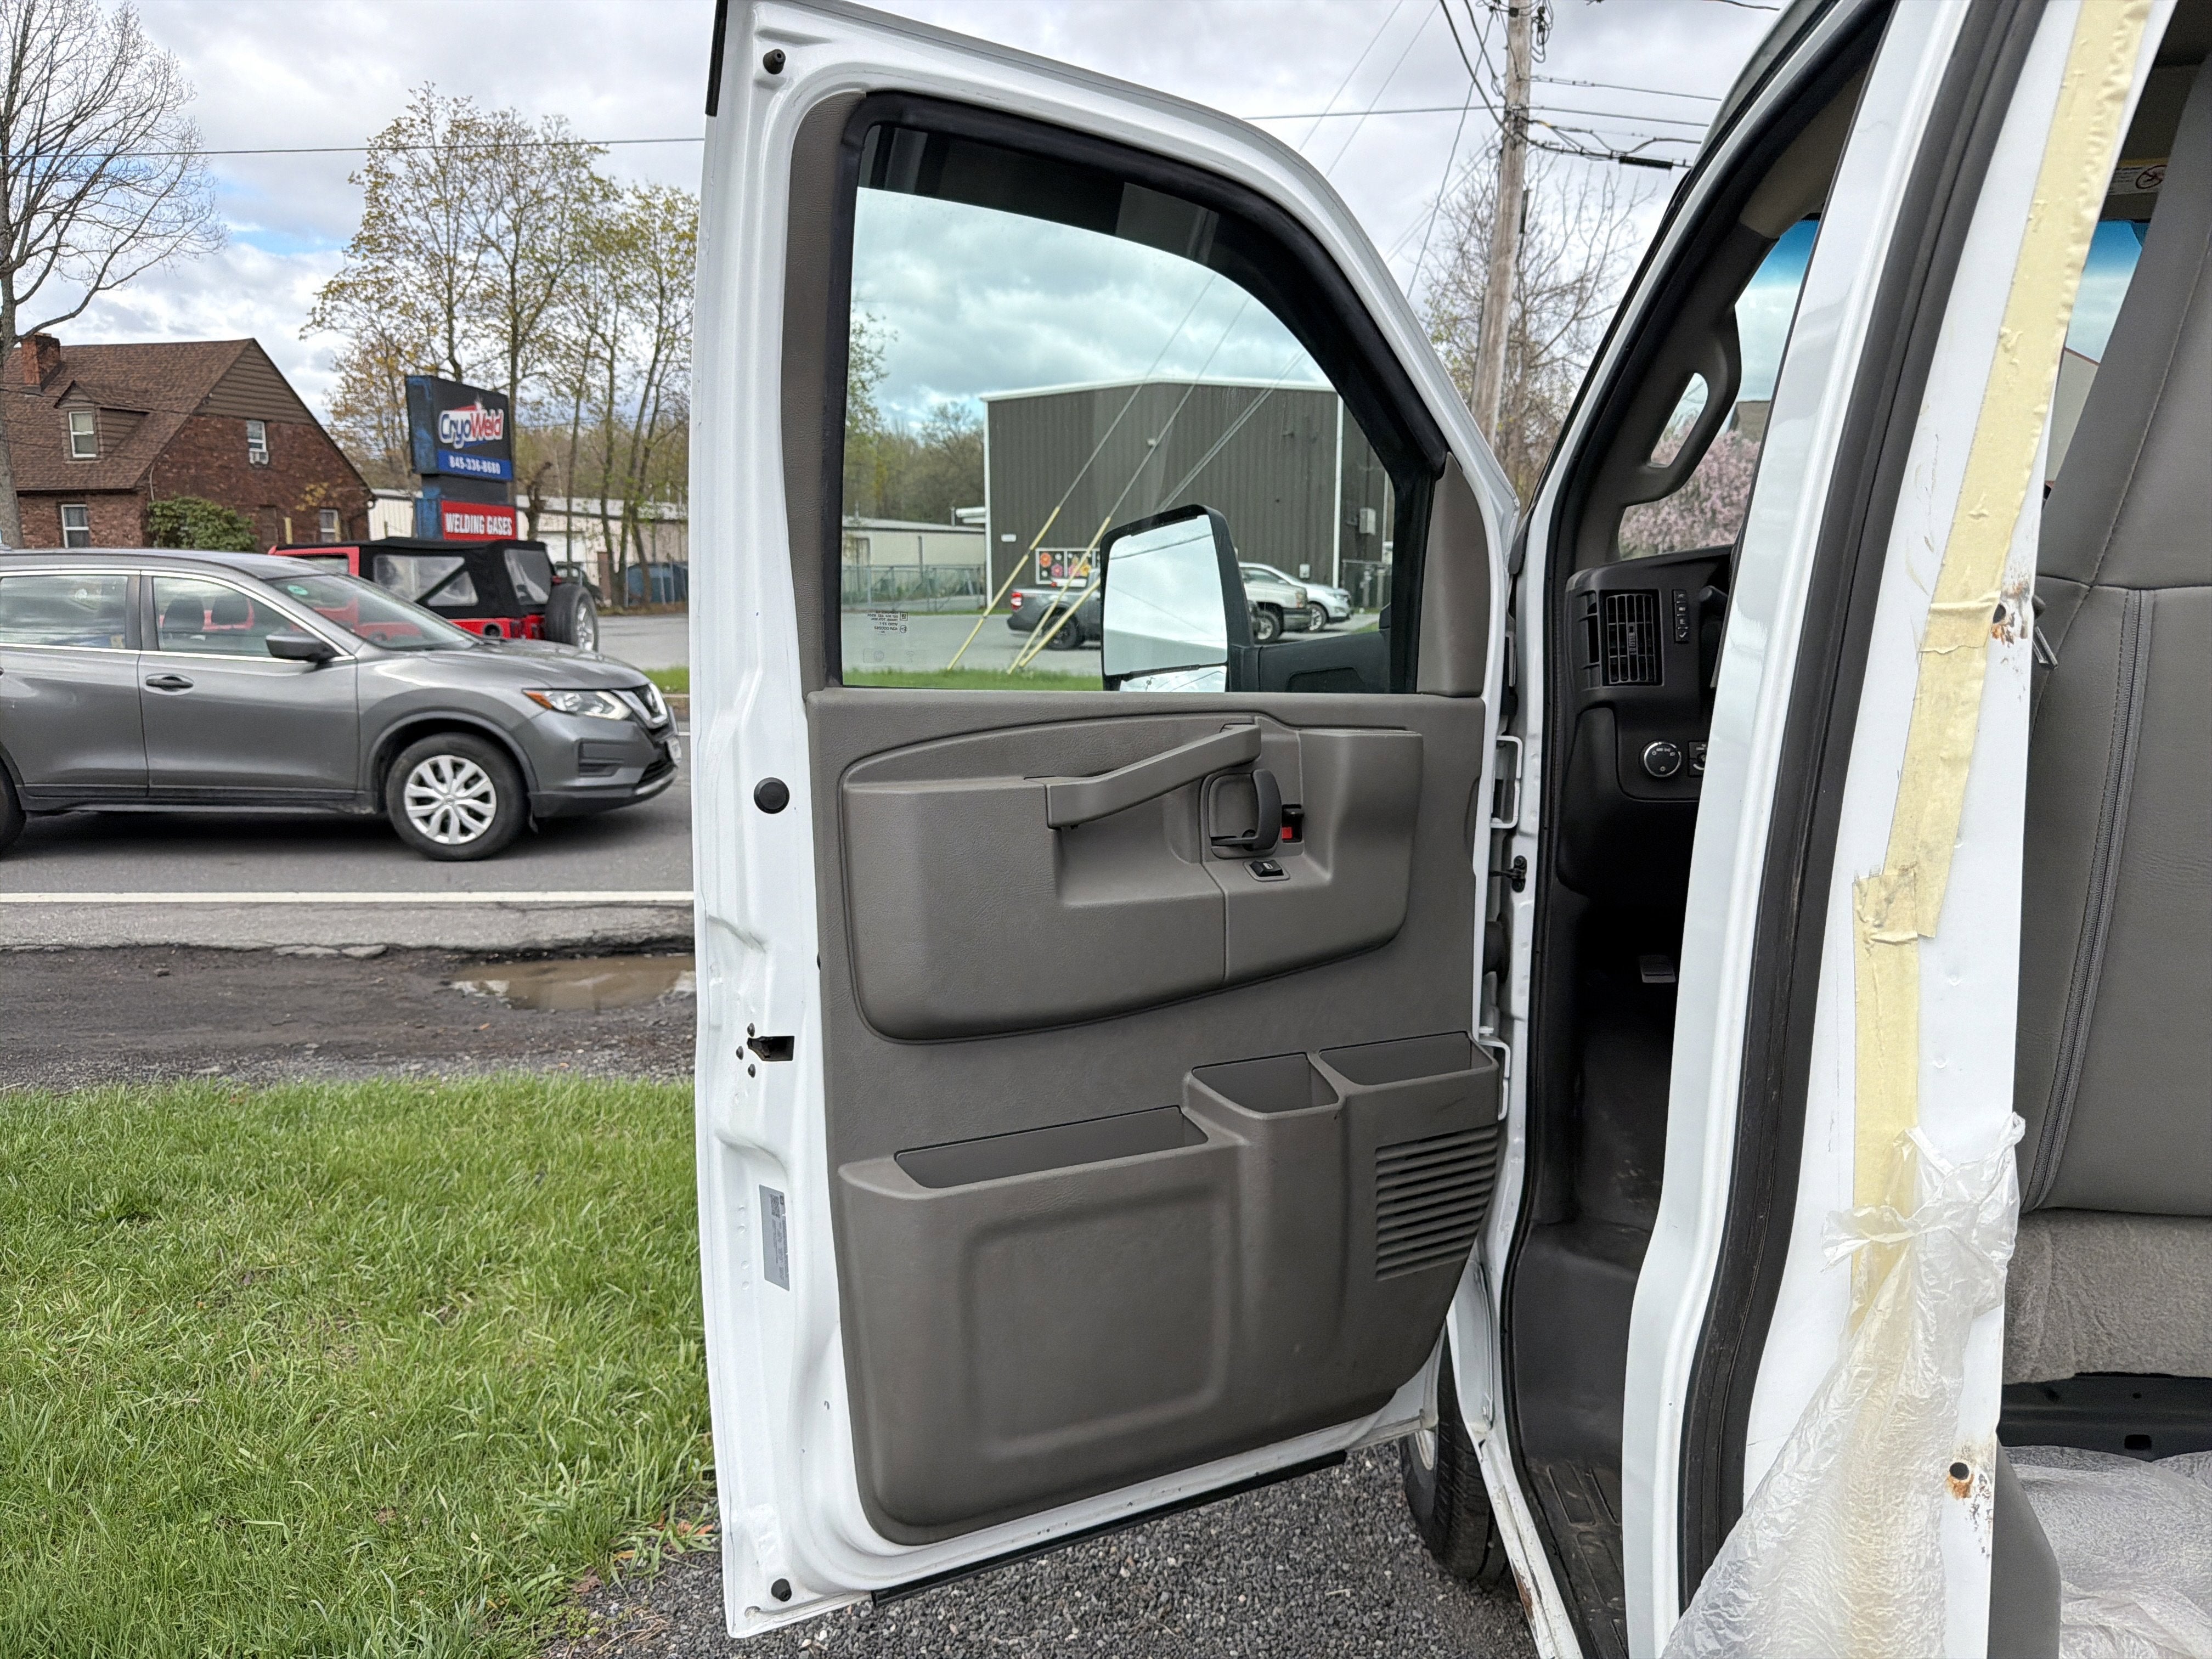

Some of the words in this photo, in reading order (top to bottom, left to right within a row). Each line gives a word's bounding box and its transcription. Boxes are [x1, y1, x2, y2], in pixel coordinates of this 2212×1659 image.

[439, 411, 503, 447] CryoWeld
[445, 512, 484, 534] WELDING
[487, 515, 512, 536] GASES
